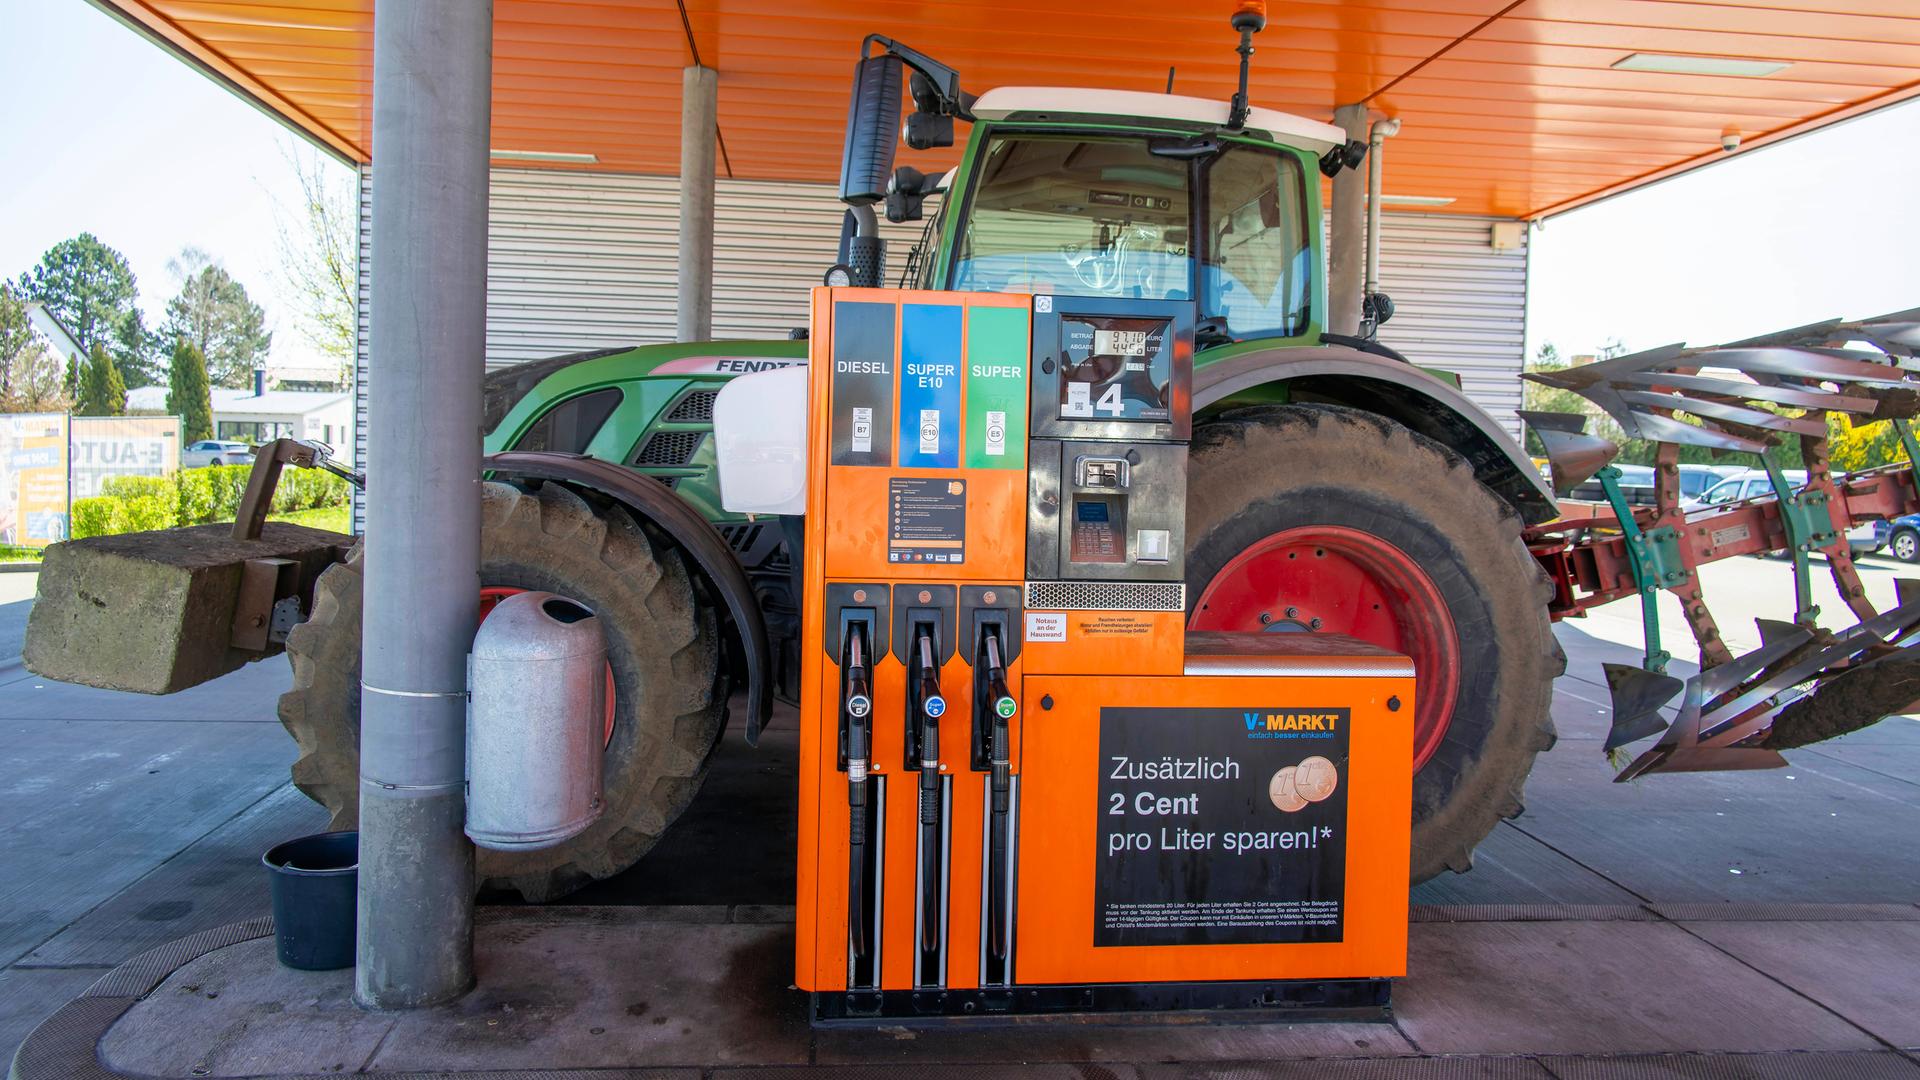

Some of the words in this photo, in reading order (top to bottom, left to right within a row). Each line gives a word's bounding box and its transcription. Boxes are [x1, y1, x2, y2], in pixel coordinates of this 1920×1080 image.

[716, 359, 789, 373] FENDT
[837, 361, 890, 375] DIESEL
[907, 363, 955, 376] SUPER
[972, 365, 1021, 378] SUPER
[918, 377, 943, 388] E10
[1096, 383, 1125, 417] 4
[857, 426, 867, 434] B7
[990, 430, 1001, 438] E5
[1244, 713, 1339, 730] V-MARKT
[1247, 731, 1273, 739] einfach
[1274, 731, 1299, 739] besser
[1301, 731, 1334, 739] einkaufen
[1110, 756, 1240, 780] Zusätzlich
[1109, 793, 1125, 815] 2
[1134, 791, 1199, 815] Cent
[1109, 832, 1152, 857] pro
[1161, 827, 1215, 851] Liter
